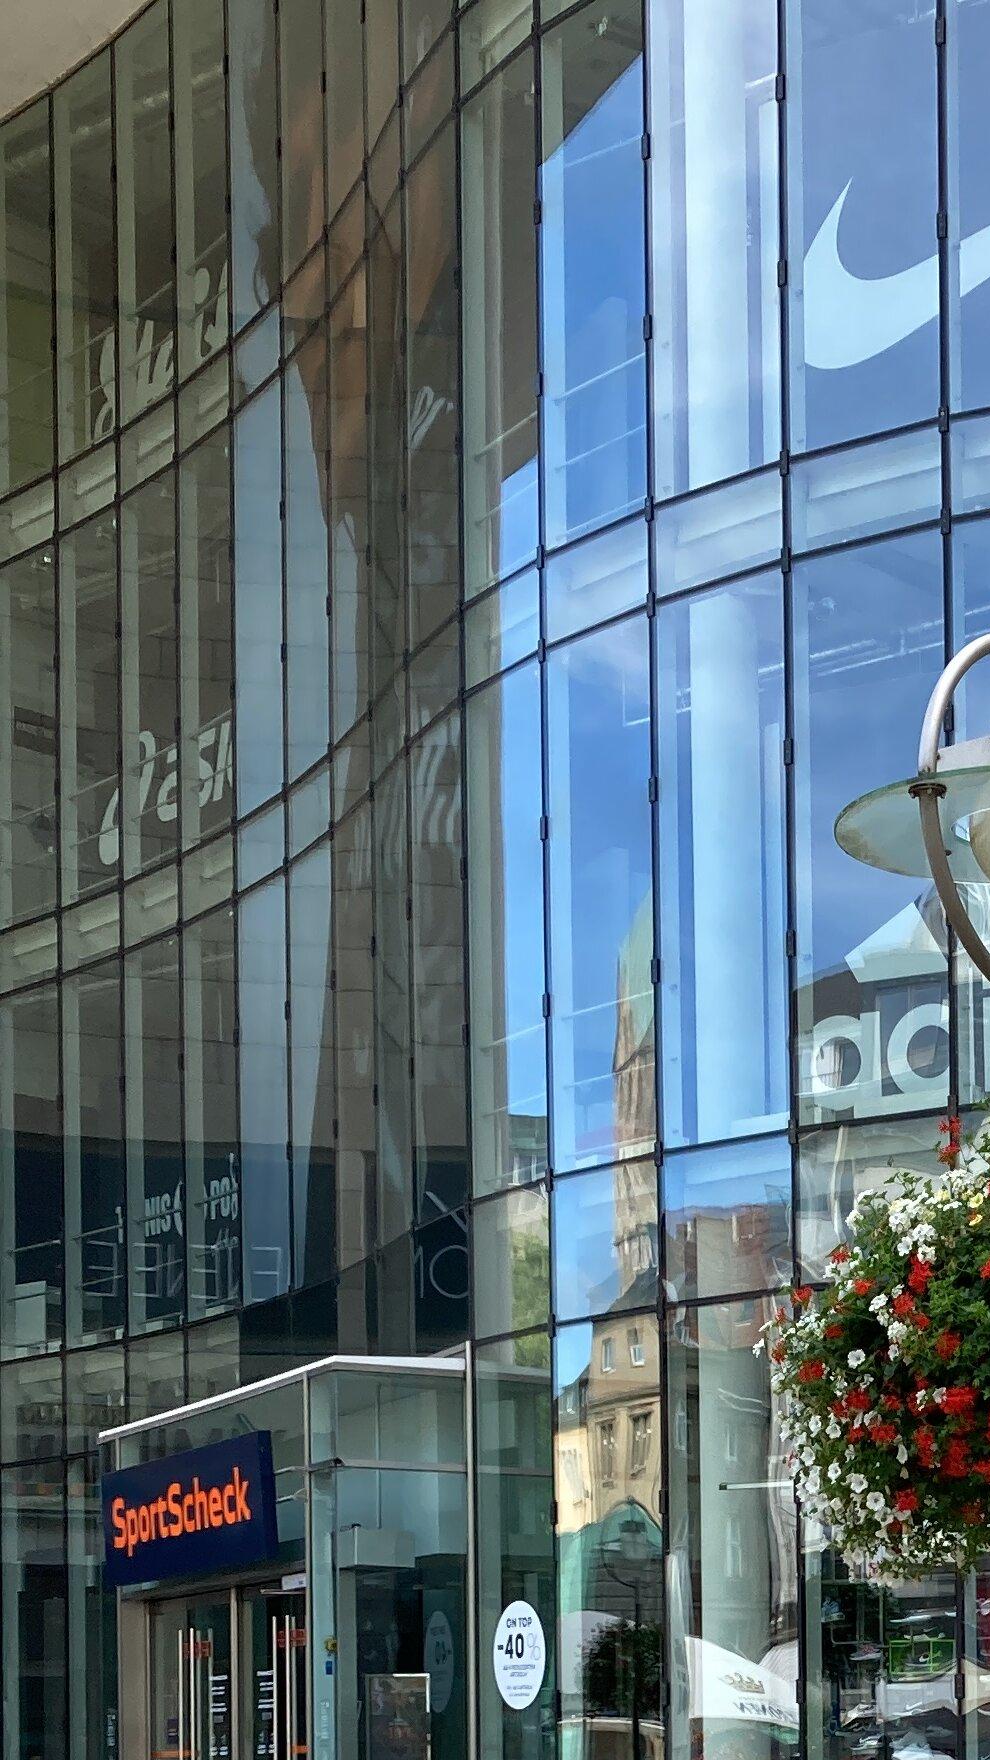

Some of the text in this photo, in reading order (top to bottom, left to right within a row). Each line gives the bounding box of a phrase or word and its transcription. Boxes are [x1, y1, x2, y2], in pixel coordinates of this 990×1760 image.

[111, 1466, 252, 1557] SportScheck
[506, 1616, 533, 1628] ON TOP
